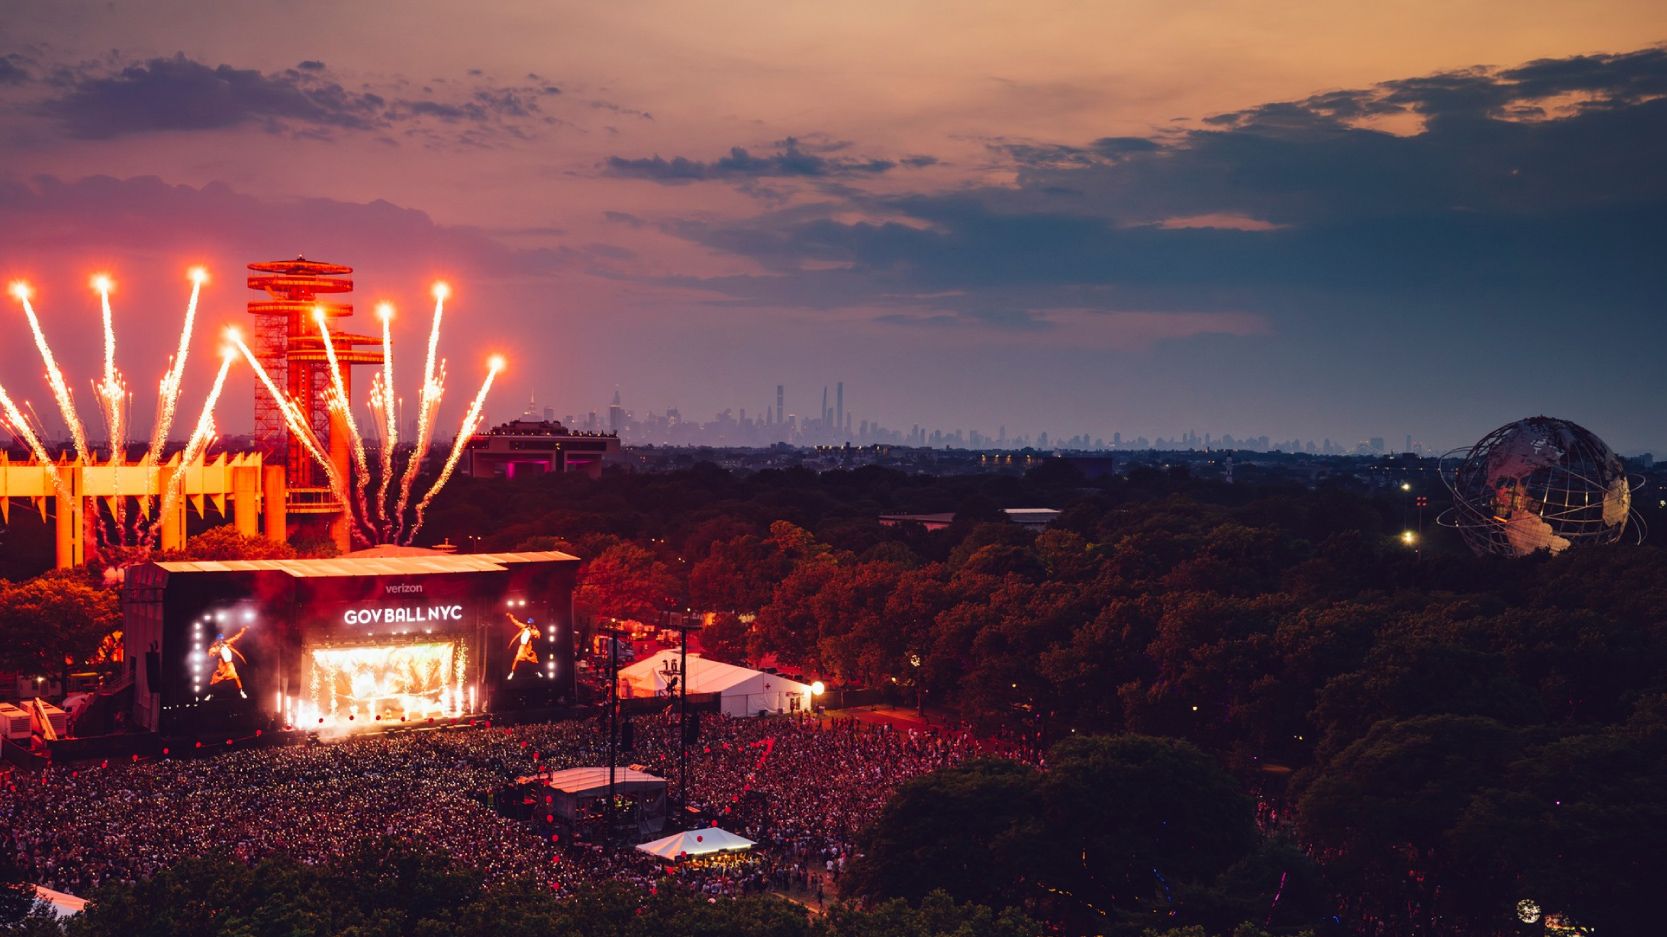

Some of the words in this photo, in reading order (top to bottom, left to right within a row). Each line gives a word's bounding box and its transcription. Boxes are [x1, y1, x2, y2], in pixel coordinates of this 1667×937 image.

[386, 583, 423, 593] verizon
[344, 609, 382, 624] GOV
[384, 607, 425, 623] BALL
[428, 605, 463, 620] NYC
